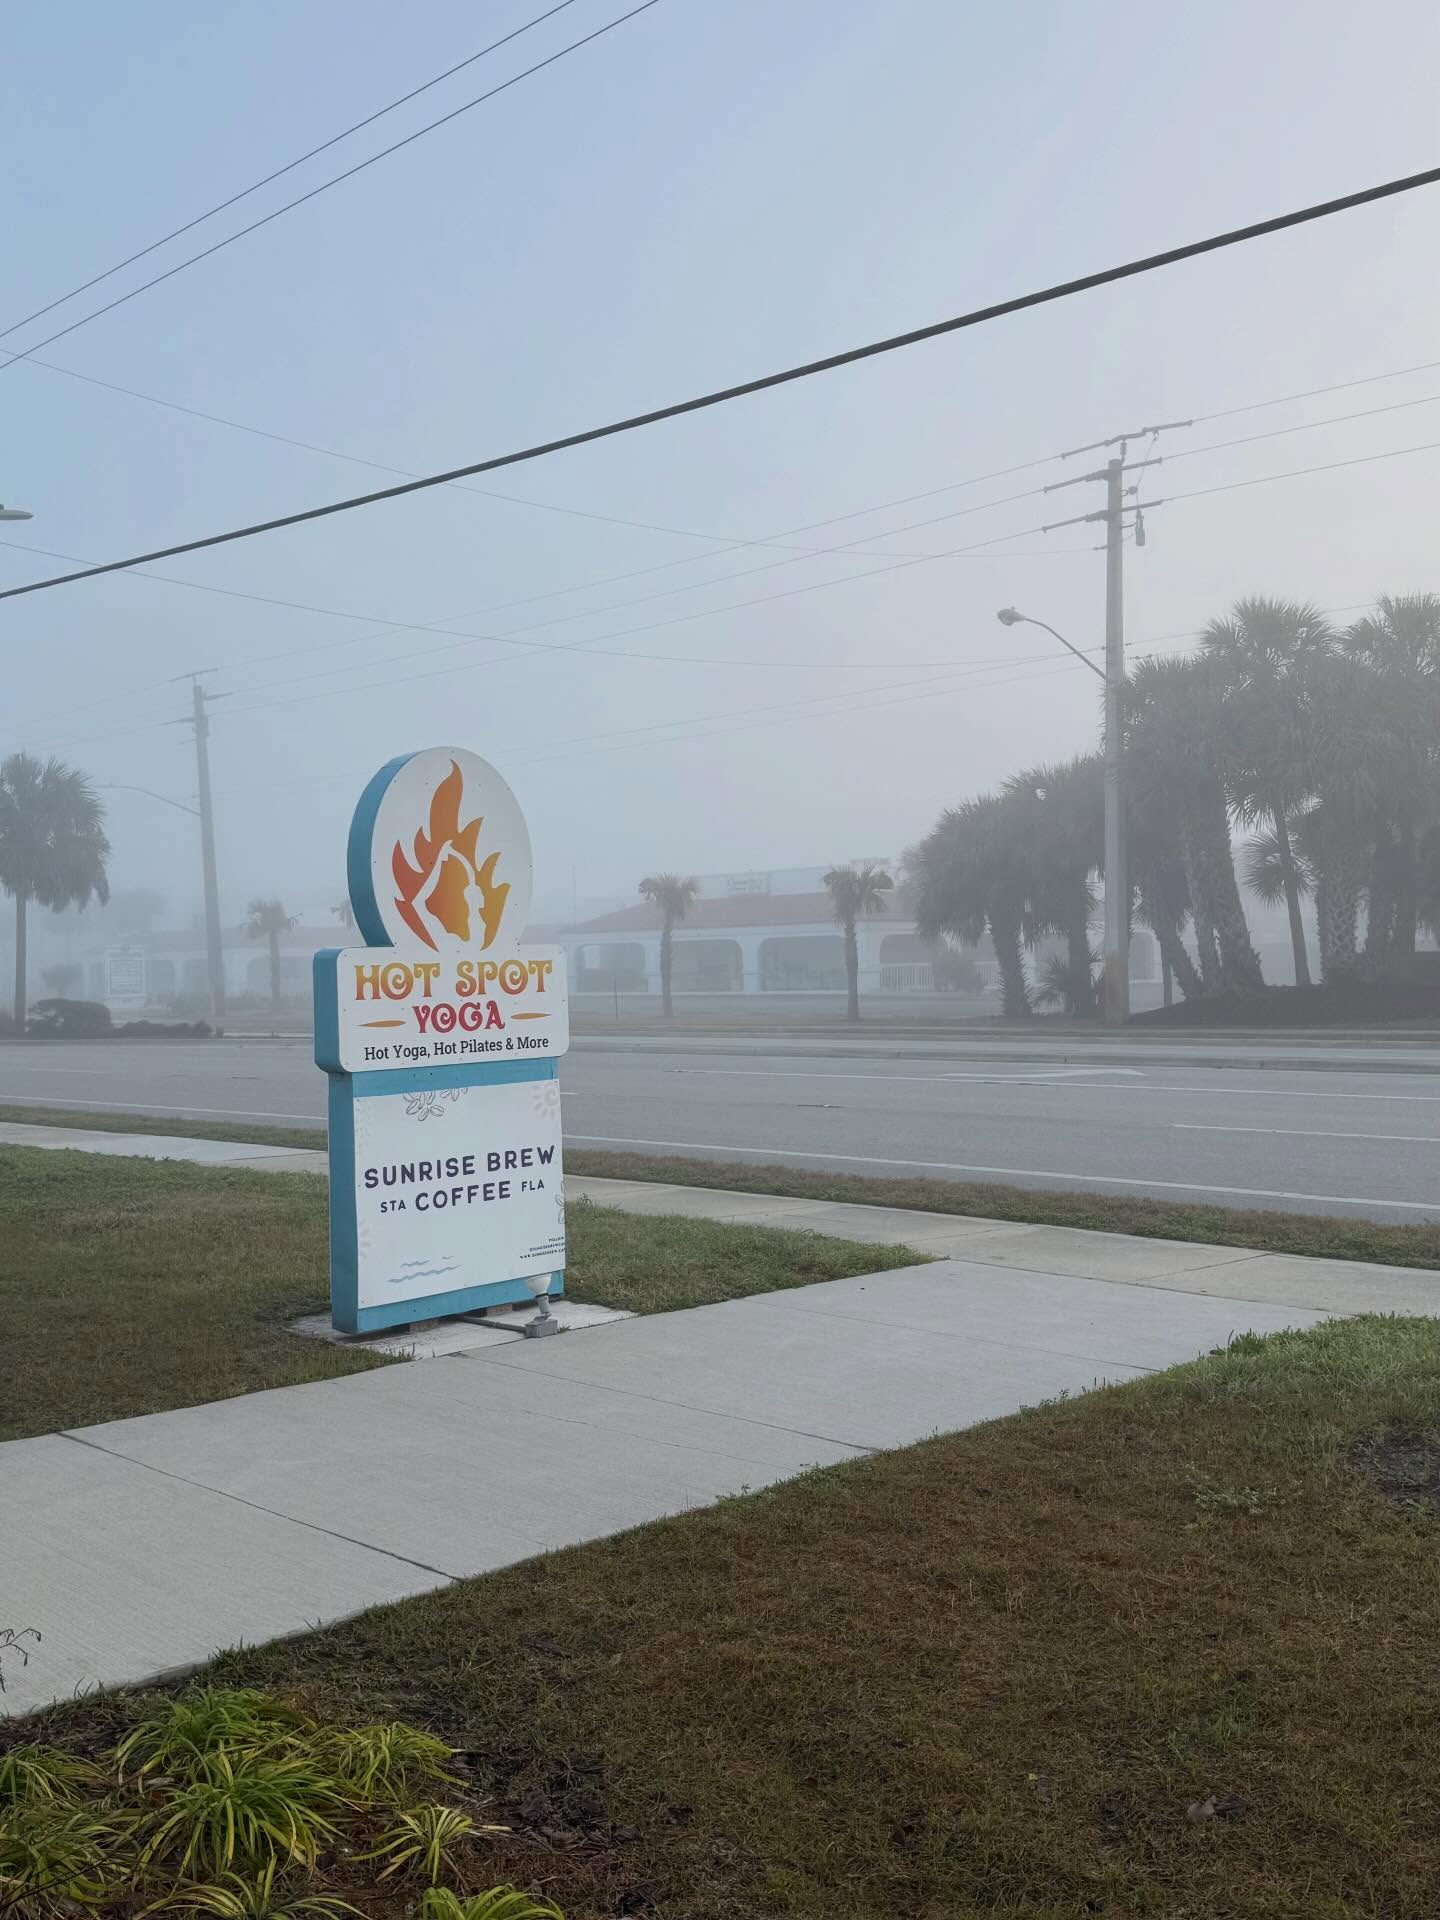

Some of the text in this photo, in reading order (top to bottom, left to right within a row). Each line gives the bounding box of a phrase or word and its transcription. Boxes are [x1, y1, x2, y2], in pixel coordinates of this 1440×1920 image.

[355, 960, 552, 1000] HOT SPOT
[412, 1000, 505, 1033] YOGA
[364, 1036, 549, 1060] Hot Yoga, Hot Pilates & More
[364, 1145, 555, 1189] SUNRISE BREW
[380, 1179, 544, 1213] STA COFFEE FLA
